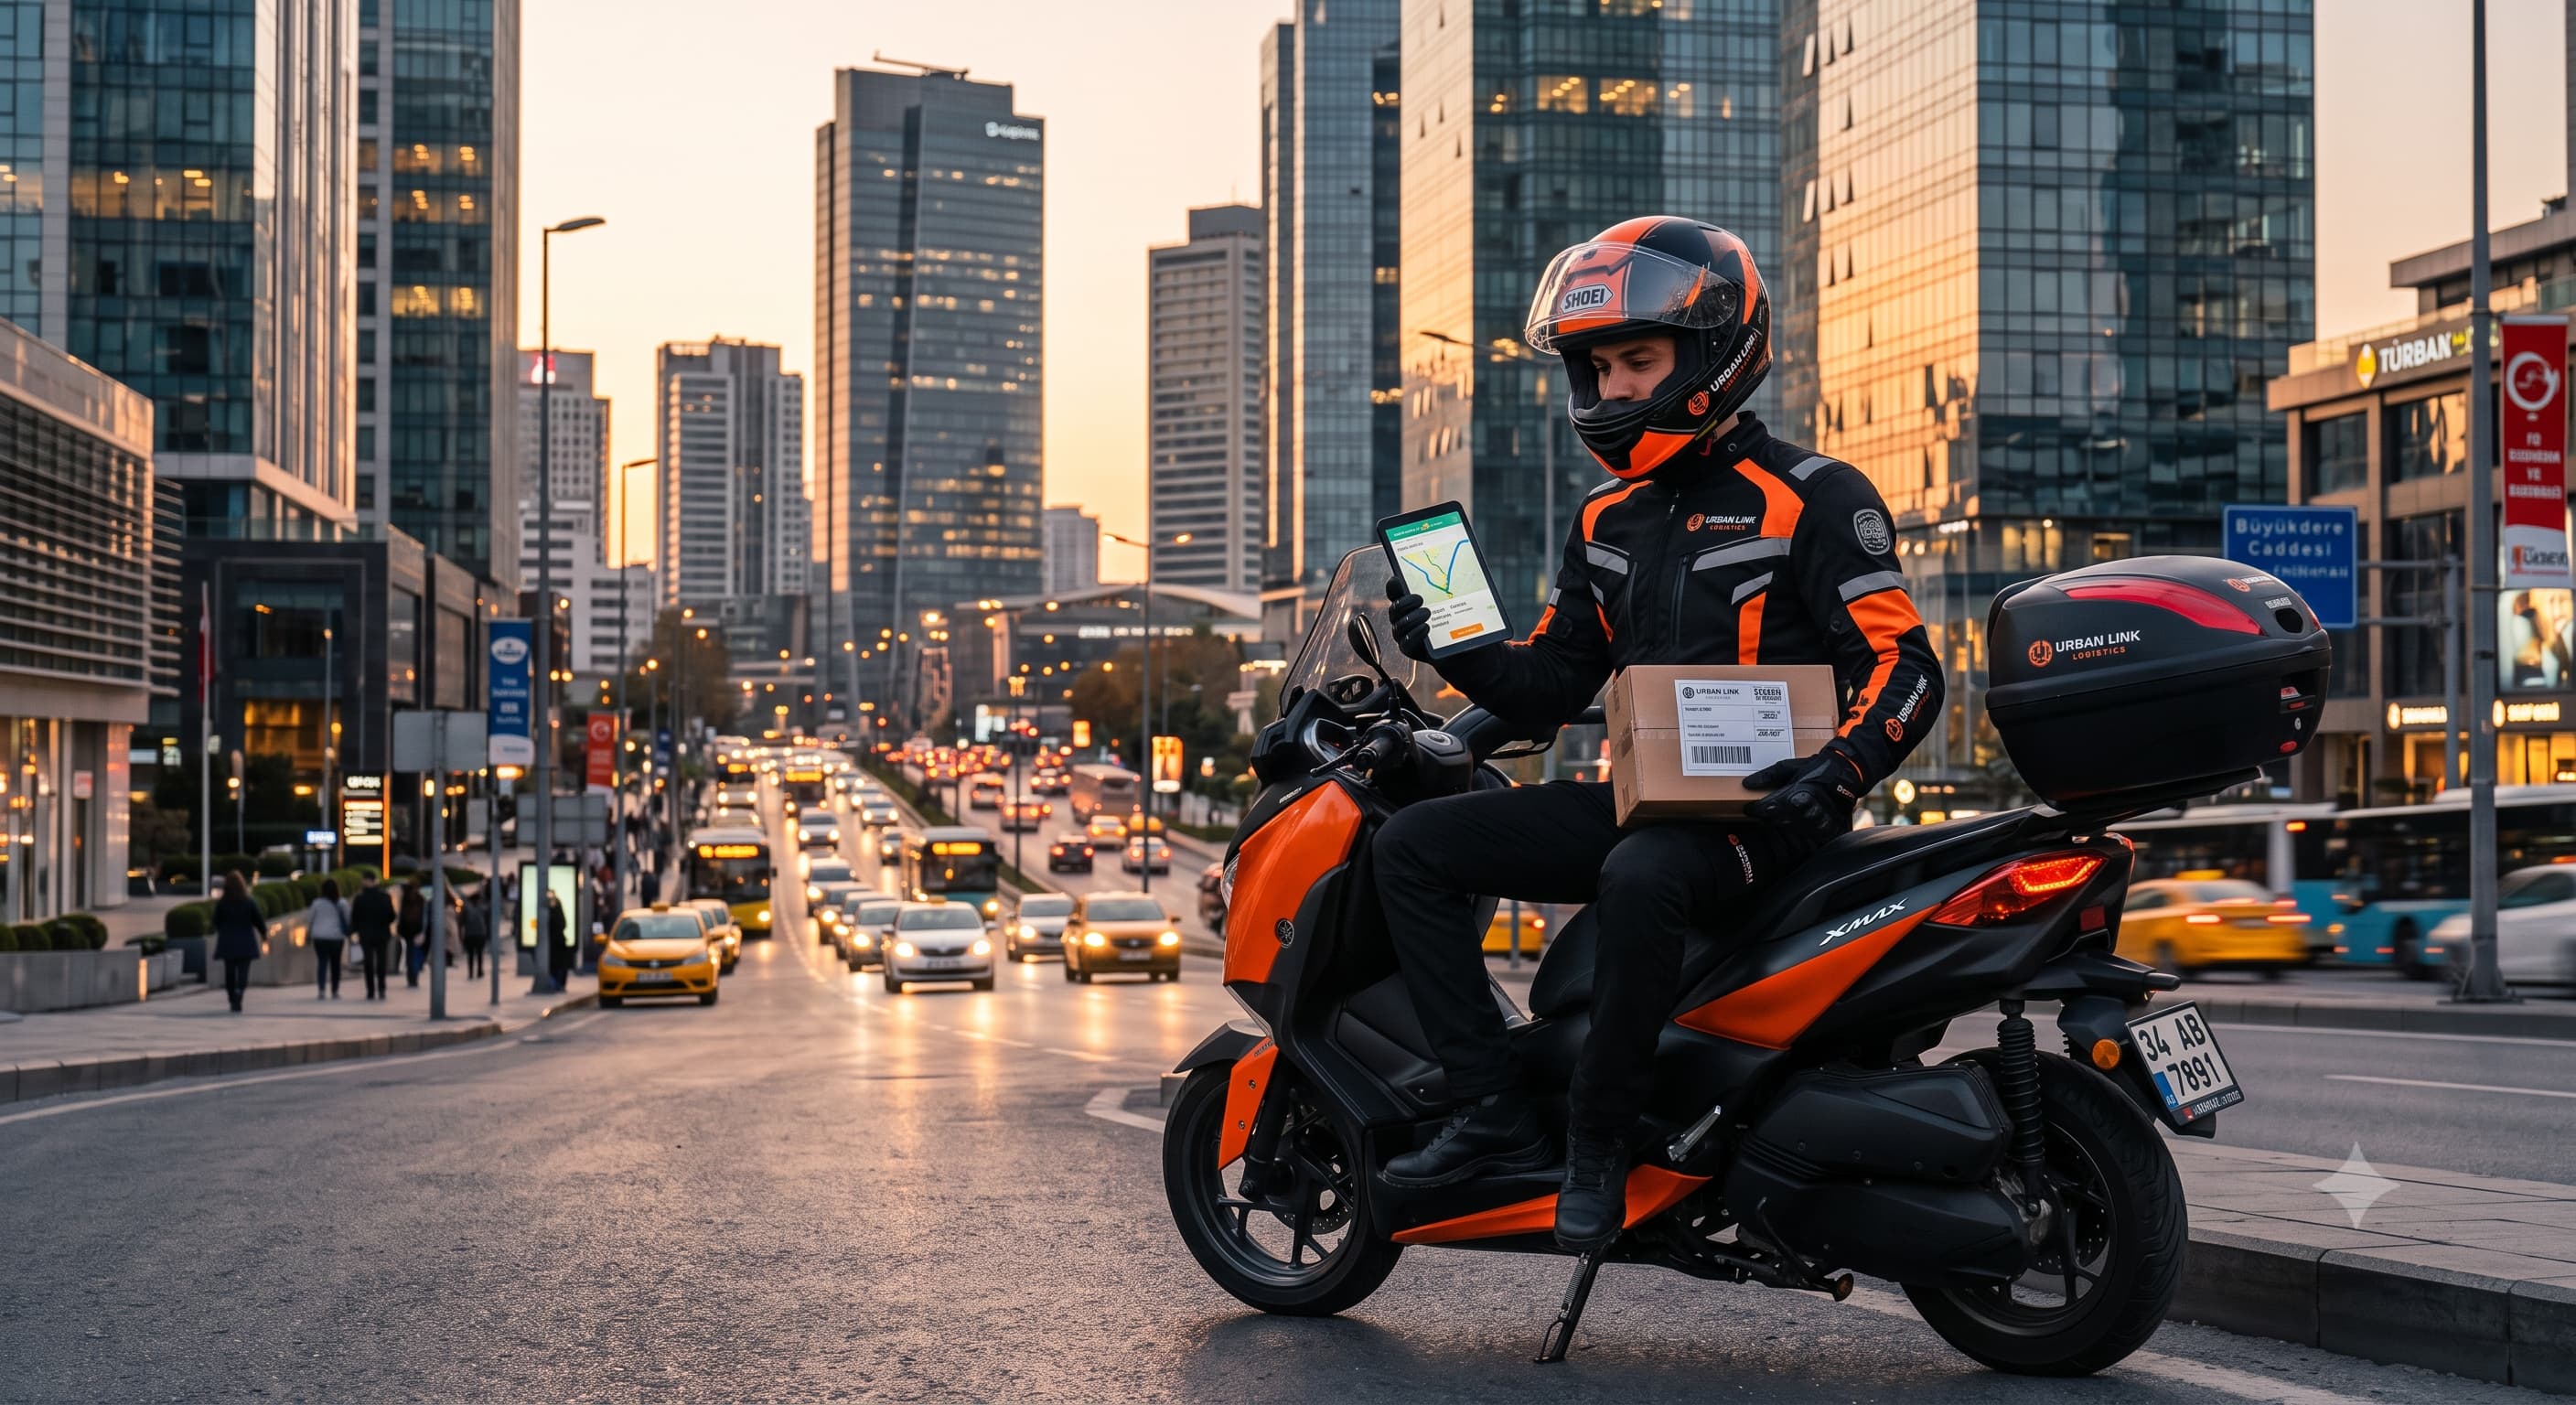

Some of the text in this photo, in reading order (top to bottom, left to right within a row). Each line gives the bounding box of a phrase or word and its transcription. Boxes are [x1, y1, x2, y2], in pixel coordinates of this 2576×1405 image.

[1564, 288, 1605, 309] SHOEI
[1705, 516, 1734, 524] URBAN
[2235, 517, 2344, 538] Büyükdere
[2248, 540, 2332, 556] Caddesi
[2055, 630, 2141, 652] URBAN LINK
[2138, 1014, 2206, 1061] 34 AB
[2166, 1052, 2221, 1096] 7891
